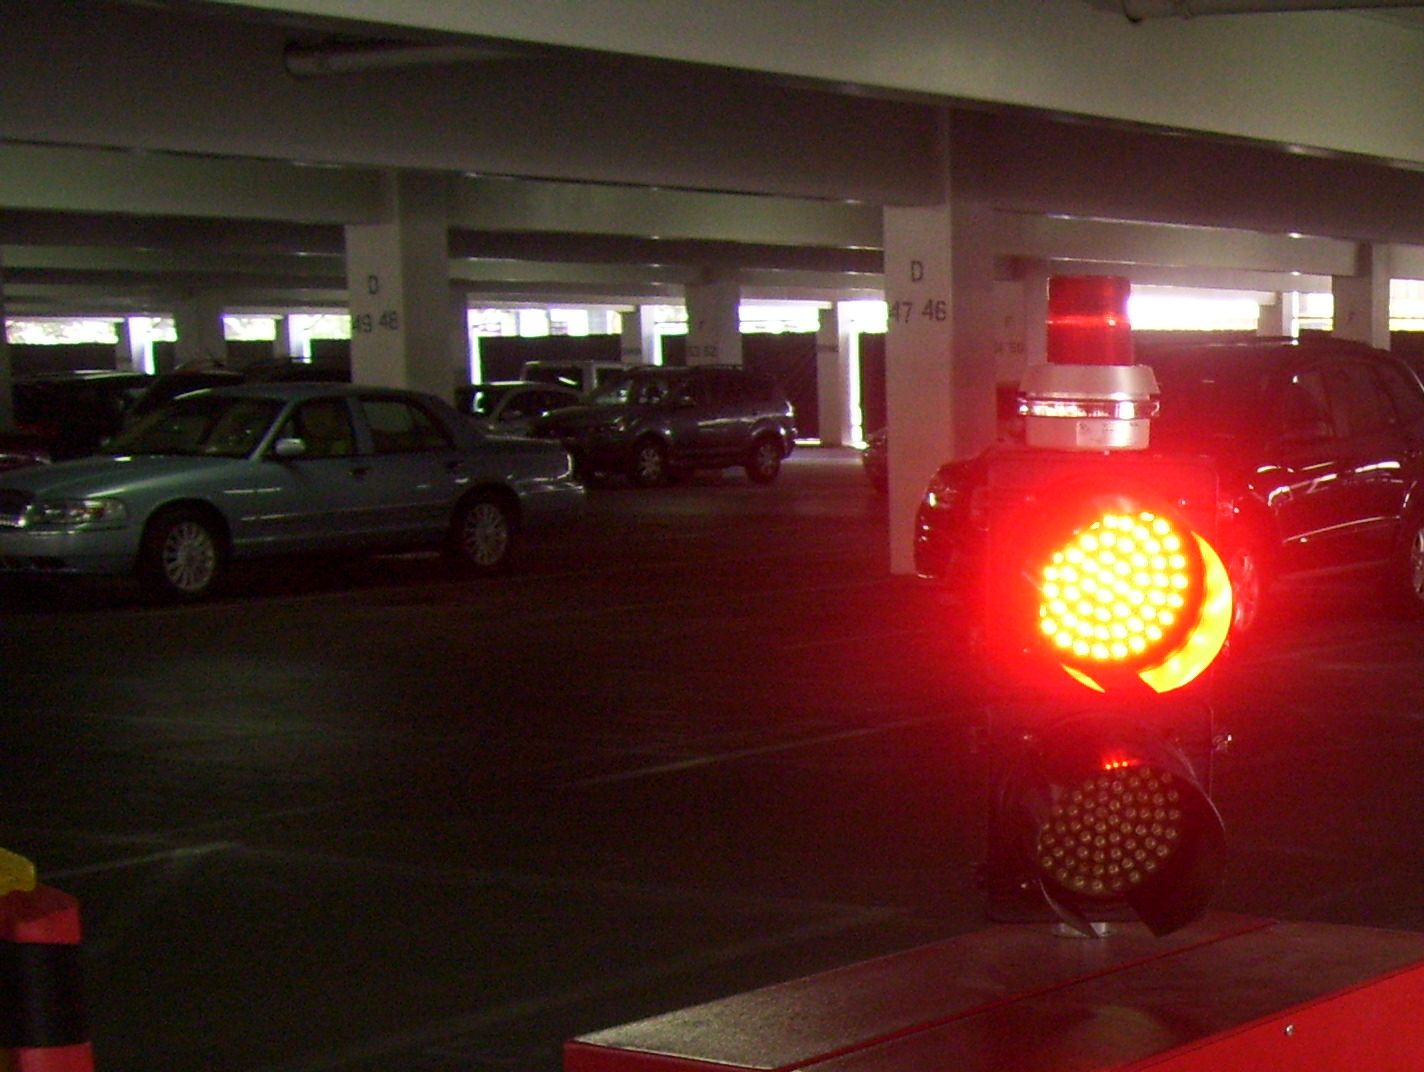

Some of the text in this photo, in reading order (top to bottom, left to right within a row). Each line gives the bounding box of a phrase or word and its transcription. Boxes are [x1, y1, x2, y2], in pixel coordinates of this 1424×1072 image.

[911, 260, 924, 282] D
[368, 275, 378, 295] D
[379, 311, 399, 330] 48
[889, 299, 947, 323] 47 46
